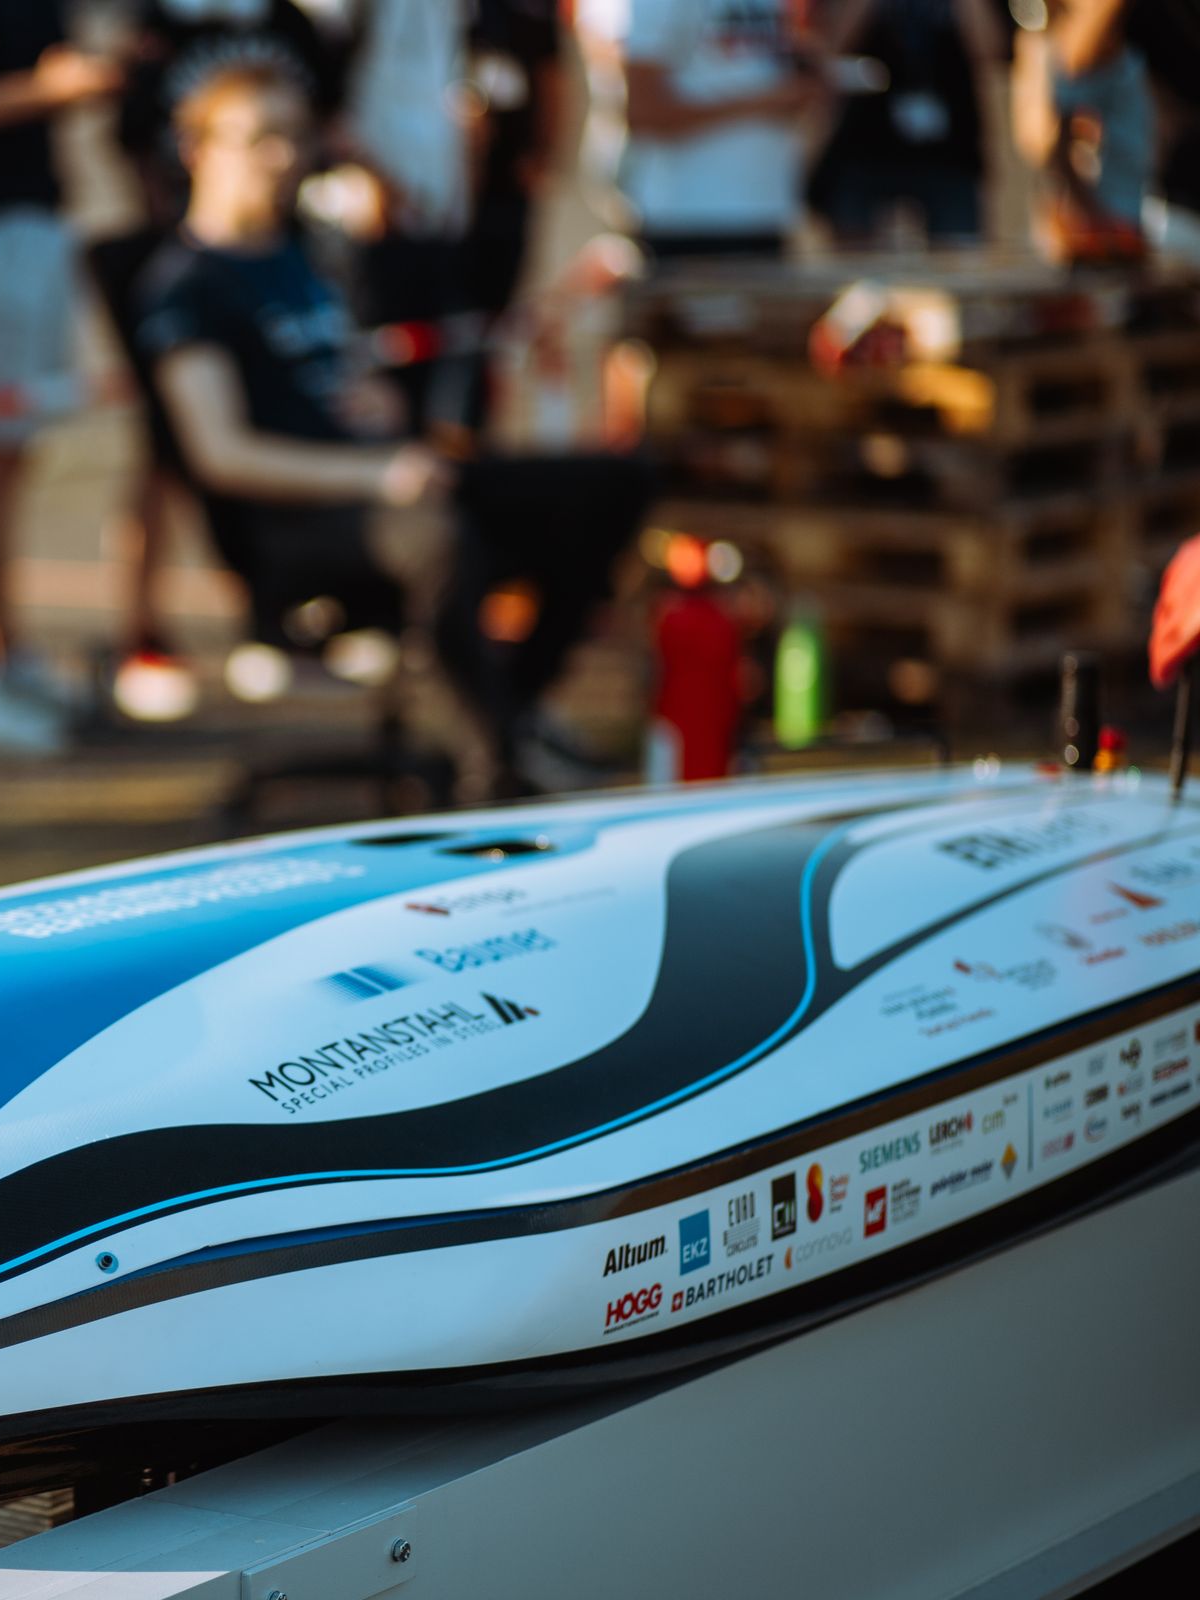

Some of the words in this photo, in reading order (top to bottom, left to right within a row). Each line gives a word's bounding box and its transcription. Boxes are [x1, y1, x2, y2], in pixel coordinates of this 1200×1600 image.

[248, 1000, 486, 1101] MONTANSTAHL
[281, 1074, 355, 1114] SPECIAL
[357, 1042, 430, 1079] PROFILES
[434, 1034, 455, 1050] IN
[928, 1113, 966, 1146] LERCH
[859, 1131, 921, 1174] SIEMENS
[728, 1192, 755, 1228] EURO
[603, 1235, 666, 1278] Altium
[682, 1237, 708, 1265] EKZ
[685, 1254, 774, 1308] BARTHOLET
